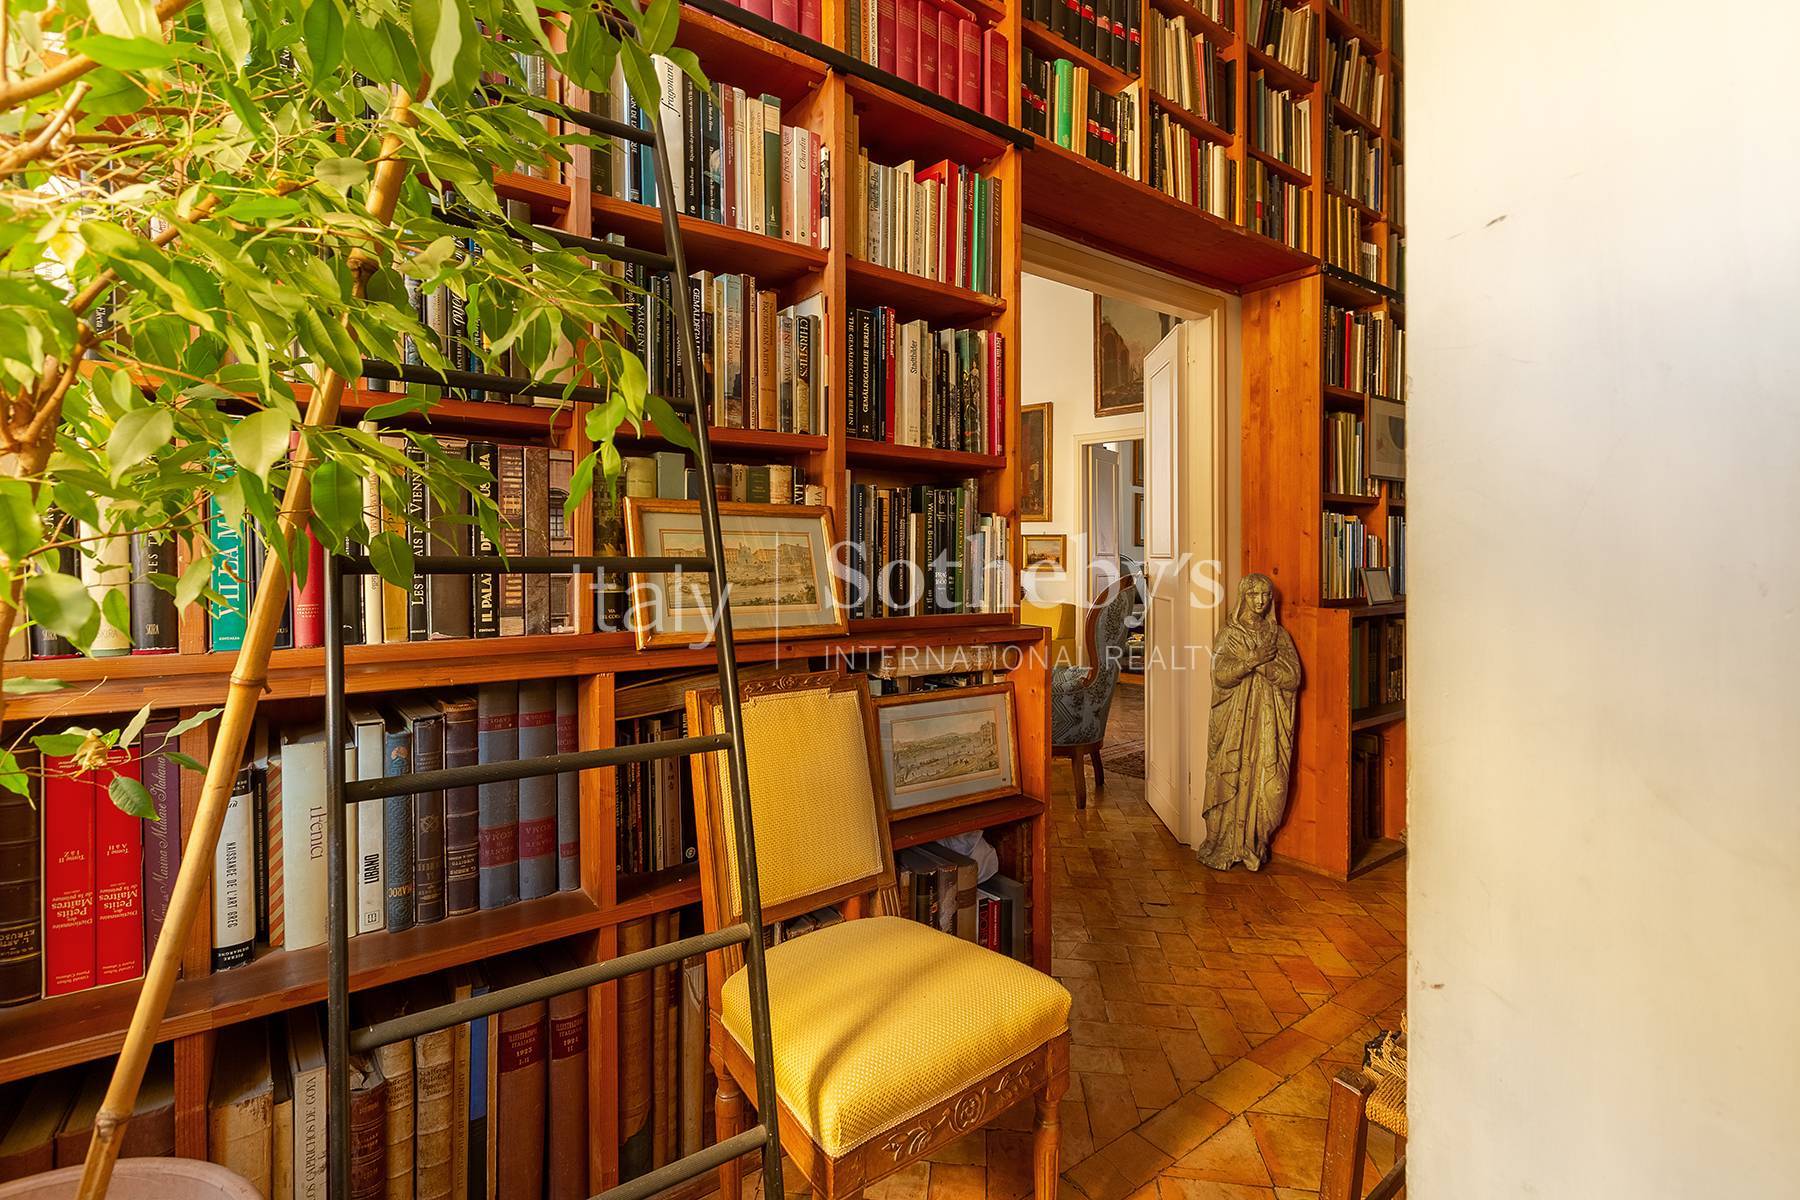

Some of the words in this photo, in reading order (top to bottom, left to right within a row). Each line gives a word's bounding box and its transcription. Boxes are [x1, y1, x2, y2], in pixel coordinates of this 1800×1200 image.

[637, 305, 645, 354] SARGENT
[411, 583, 424, 606] LES
[481, 609, 493, 622] IL
[226, 841, 239, 878] NAISSANCE
[364, 853, 380, 885] LIBANO
[226, 879, 238, 889] DE
[99, 889, 138, 901] Maîtres
[226, 891, 238, 909] L'ART
[51, 896, 93, 910] Maîtres
[103, 898, 132, 910] Petits
[56, 907, 87, 918] Petits
[226, 911, 238, 929] GREC
[559, 1026, 583, 1038] ITALIANA
[511, 1037, 536, 1049] ITALIANA
[305, 1076, 316, 1105] GOYA
[305, 1108, 316, 1123] DE
[305, 1125, 316, 1182] CAPRICHOS
